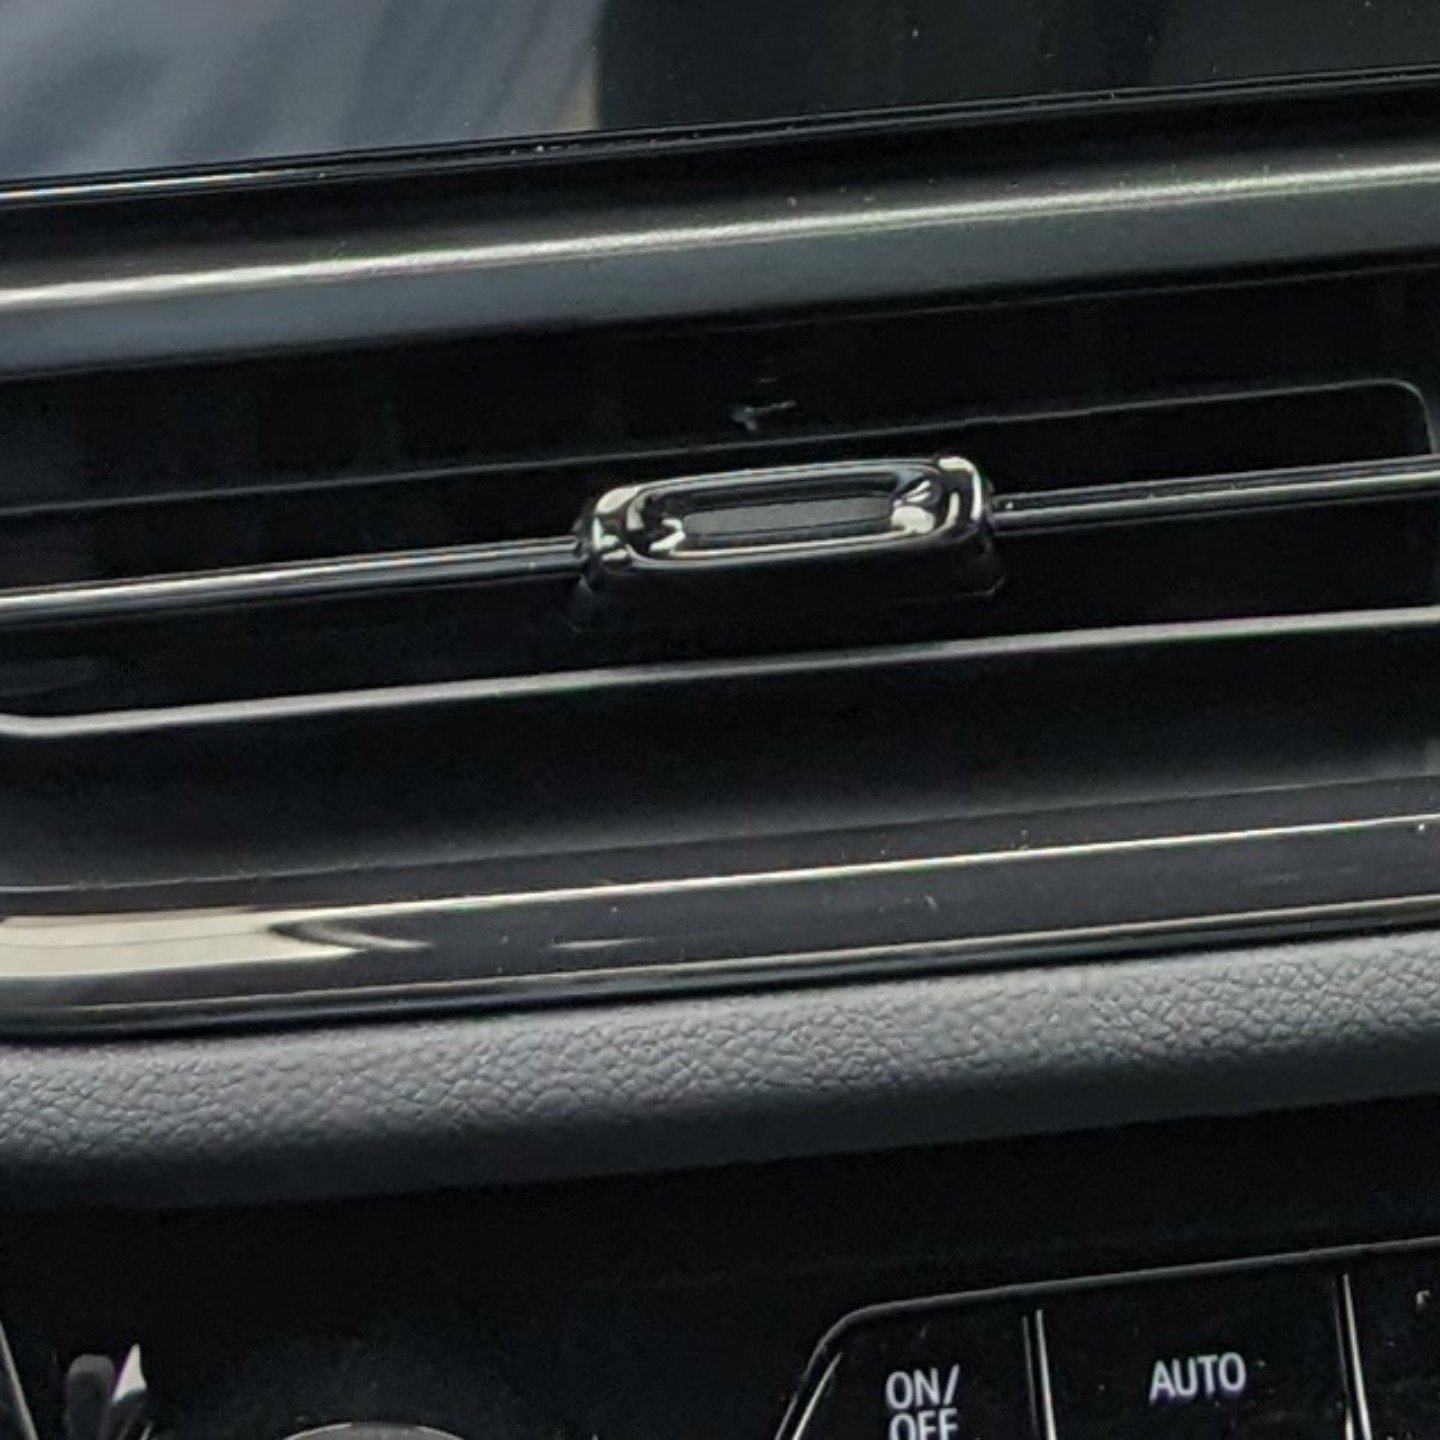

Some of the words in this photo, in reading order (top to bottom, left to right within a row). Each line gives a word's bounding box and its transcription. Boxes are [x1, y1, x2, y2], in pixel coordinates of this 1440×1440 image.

[885, 1363, 960, 1410] ON/
[1148, 1351, 1248, 1404] AUTO
[889, 1407, 959, 1440] OFF
